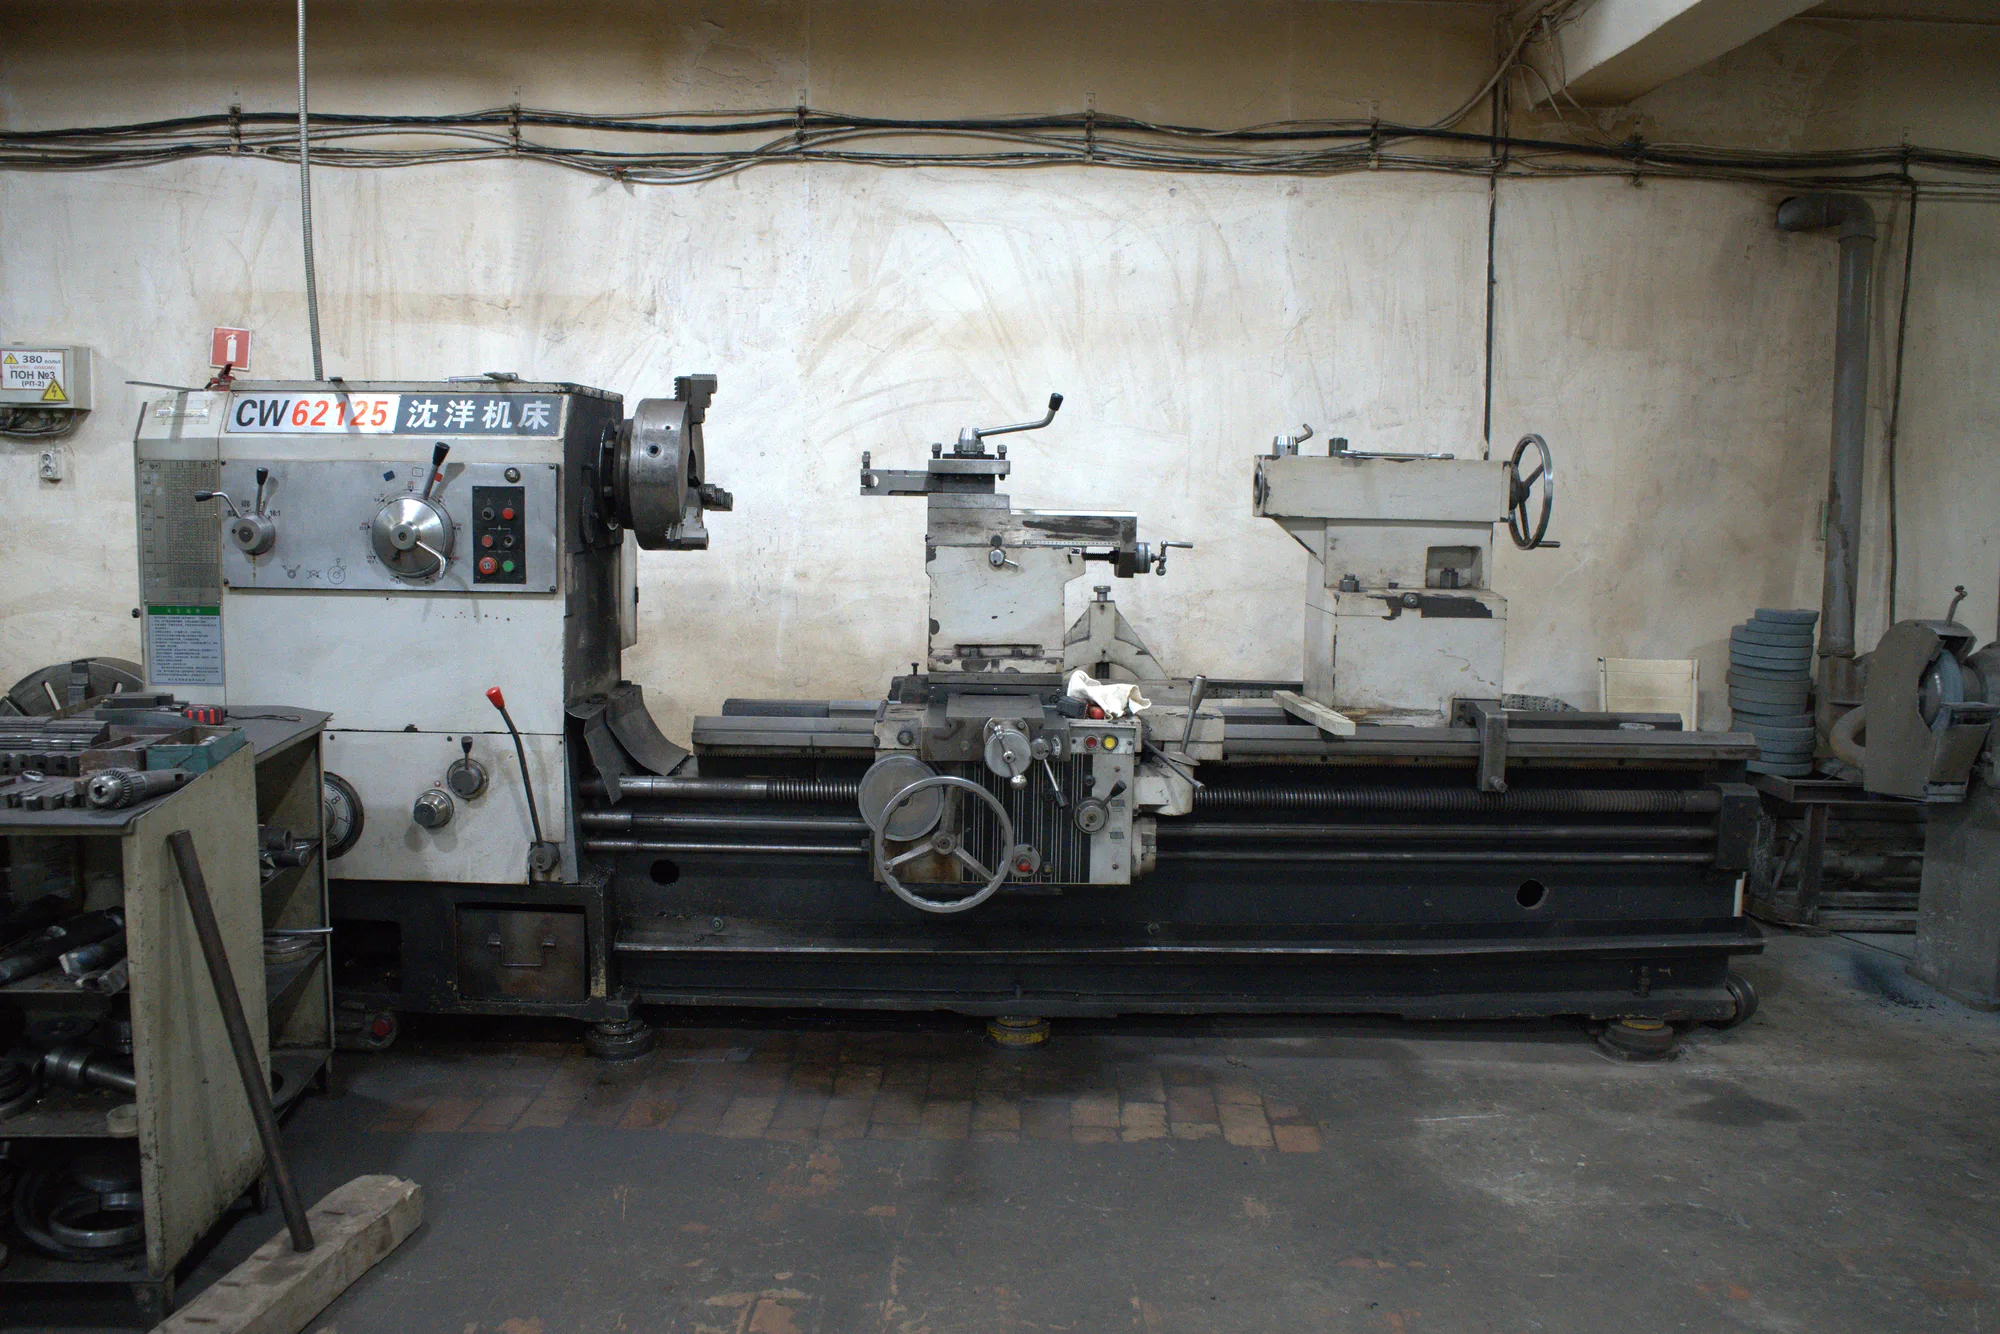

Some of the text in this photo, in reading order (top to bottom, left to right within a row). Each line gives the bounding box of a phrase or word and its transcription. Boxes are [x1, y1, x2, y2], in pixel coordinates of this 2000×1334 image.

[22, 355, 42, 364] 380
[10, 370, 55, 379] ПОН №3
[406, 399, 551, 430] 沈洋机床
